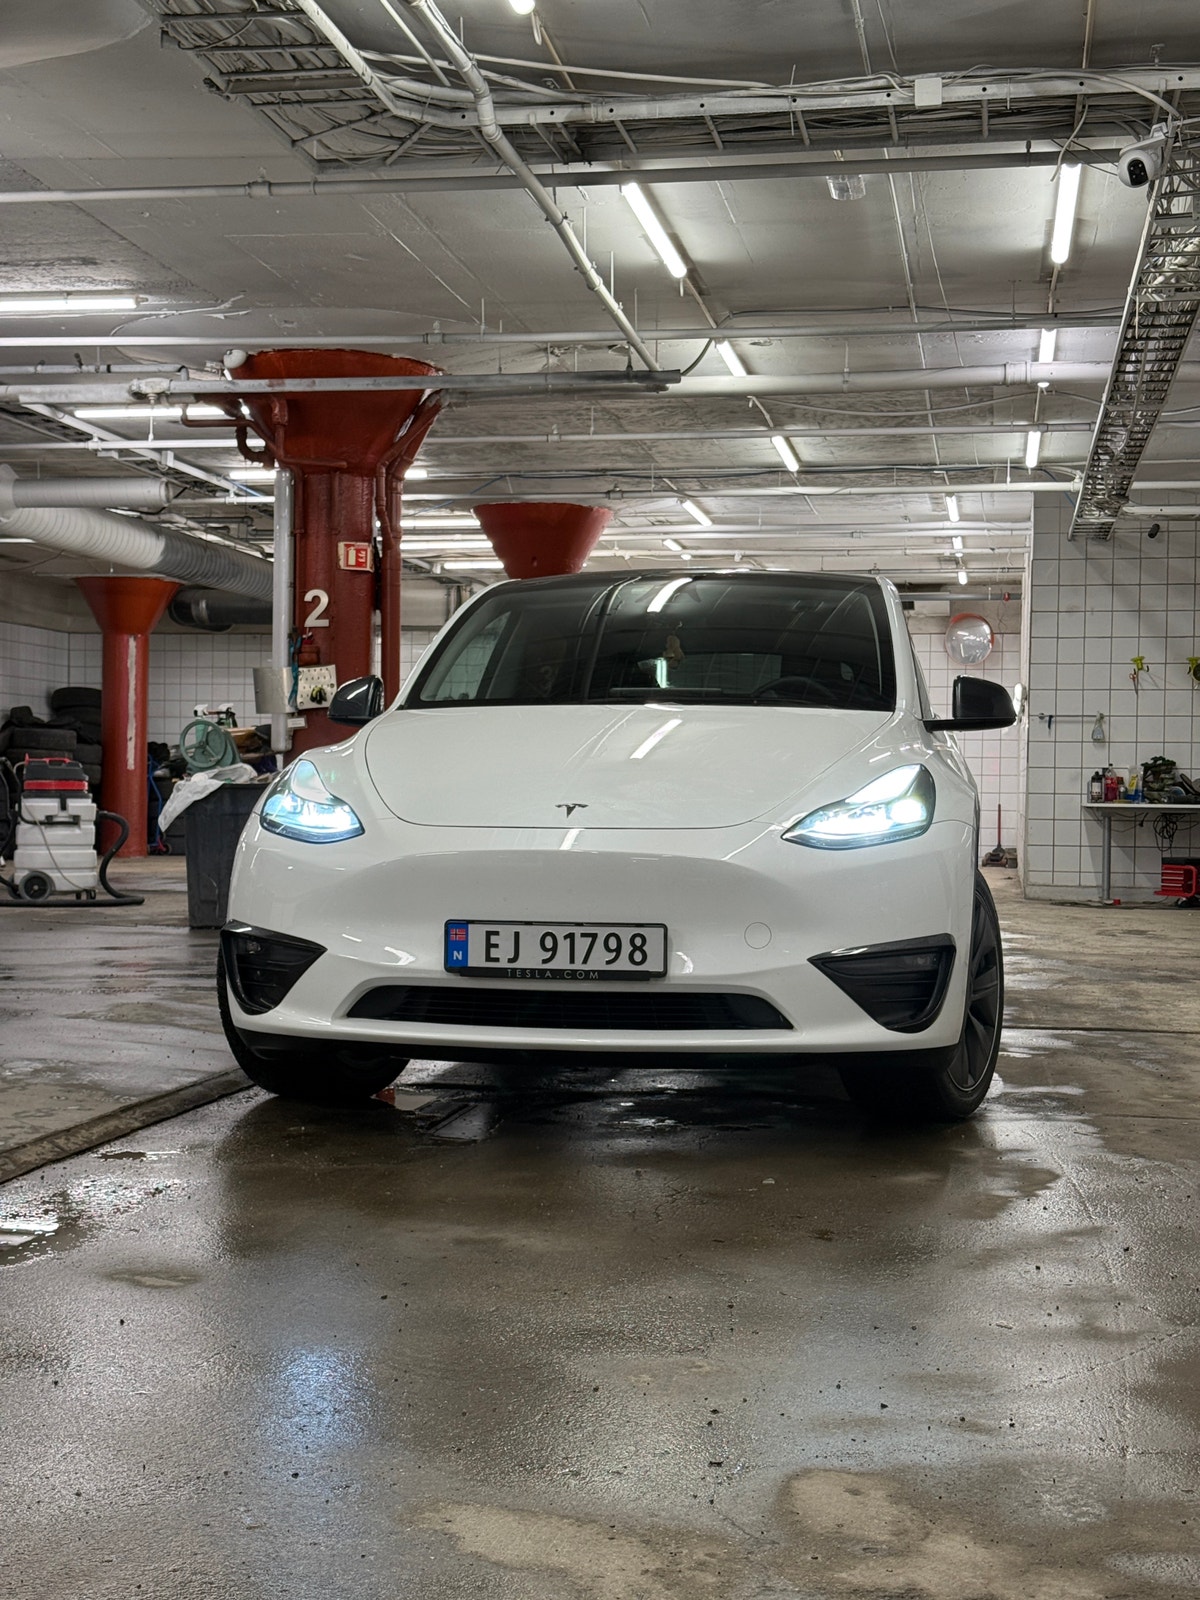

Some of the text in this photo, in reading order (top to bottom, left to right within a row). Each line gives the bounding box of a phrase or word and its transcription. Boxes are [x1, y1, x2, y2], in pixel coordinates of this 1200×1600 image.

[303, 589, 330, 628] 2
[453, 951, 462, 960] N
[484, 930, 648, 966] EJ 91798
[507, 969, 599, 980] TESLA.COM
